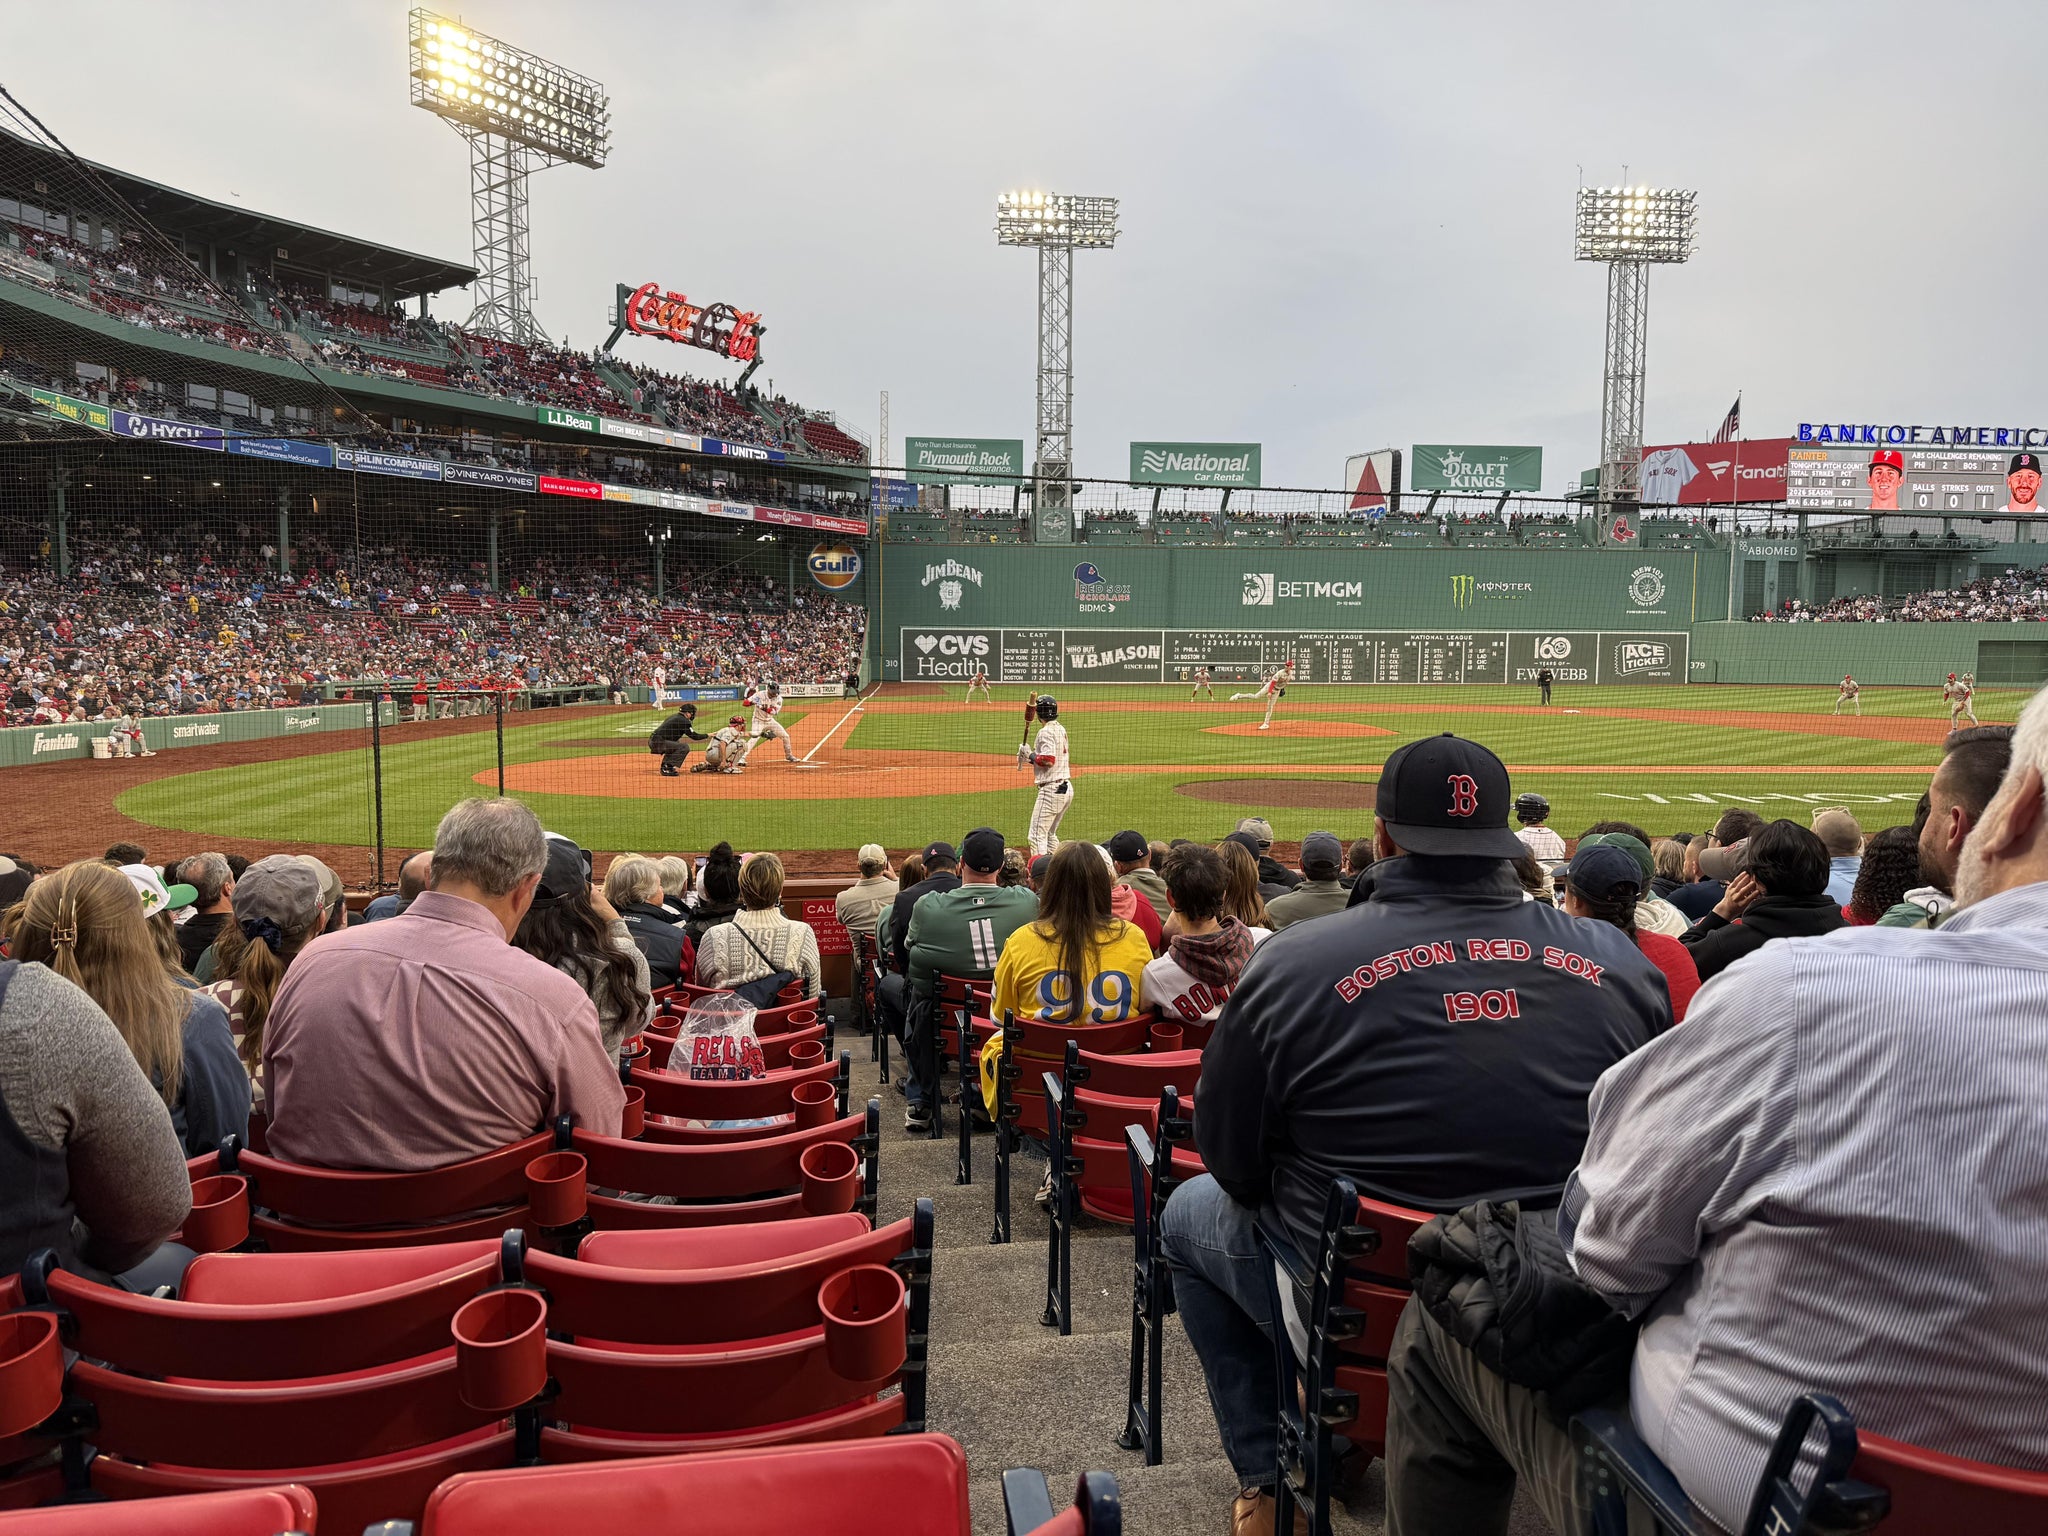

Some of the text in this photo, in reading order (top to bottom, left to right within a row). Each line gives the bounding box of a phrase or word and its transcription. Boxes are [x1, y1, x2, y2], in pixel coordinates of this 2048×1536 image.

[608, 424, 624, 434] PITCH
[625, 427, 643, 437] BREAK
[1799, 423, 1876, 443] BANK
[1887, 424, 1922, 443] OF
[732, 445, 768, 459] UNITED
[919, 450, 1011, 466] Plymouth Rock
[1790, 451, 1828, 461] PAINTER
[1926, 452, 1967, 460] CHALLENGES
[383, 458, 440, 472] COMPANIES
[1963, 462, 1977, 470] BOS
[2020, 455, 2030, 465] B
[1442, 462, 1508, 477] DRAFT
[1663, 467, 1678, 476] SOX
[456, 469, 533, 486] VINEYARD VINES
[1194, 473, 1244, 481] Car Rental
[1450, 476, 1506, 488] KINGS
[1919, 494, 1958, 508] 0 0
[1747, 546, 1798, 556] ABIOMED
[810, 556, 857, 572] Gulf
[1631, 566, 1664, 580] IBEW 103
[1079, 584, 1131, 594] RED SOX
[1278, 581, 1362, 598] BETMGM
[1476, 581, 1532, 592] MONSTER
[1079, 594, 1131, 602] SCHOLARS
[1079, 604, 1107, 613] BIDMC
[938, 634, 989, 656] CVS
[1066, 646, 1081, 654] WHO
[1625, 643, 1665, 659] ACE
[885, 659, 898, 667] 310
[917, 657, 989, 677] Health
[1626, 657, 1665, 669] TICKET
[1690, 661, 1706, 670] 379
[299, 717, 320, 729] TICKET
[173, 722, 221, 740] smartwater
[1446, 774, 1479, 817] B
[968, 918, 998, 969] 11
[1335, 938, 1605, 1003] BOSTON RED SOX
[1034, 969, 1133, 1026] 99
[1171, 975, 1239, 1023] BON
[1442, 988, 1521, 1023] 1901
[692, 1067, 729, 1079] TEAM
